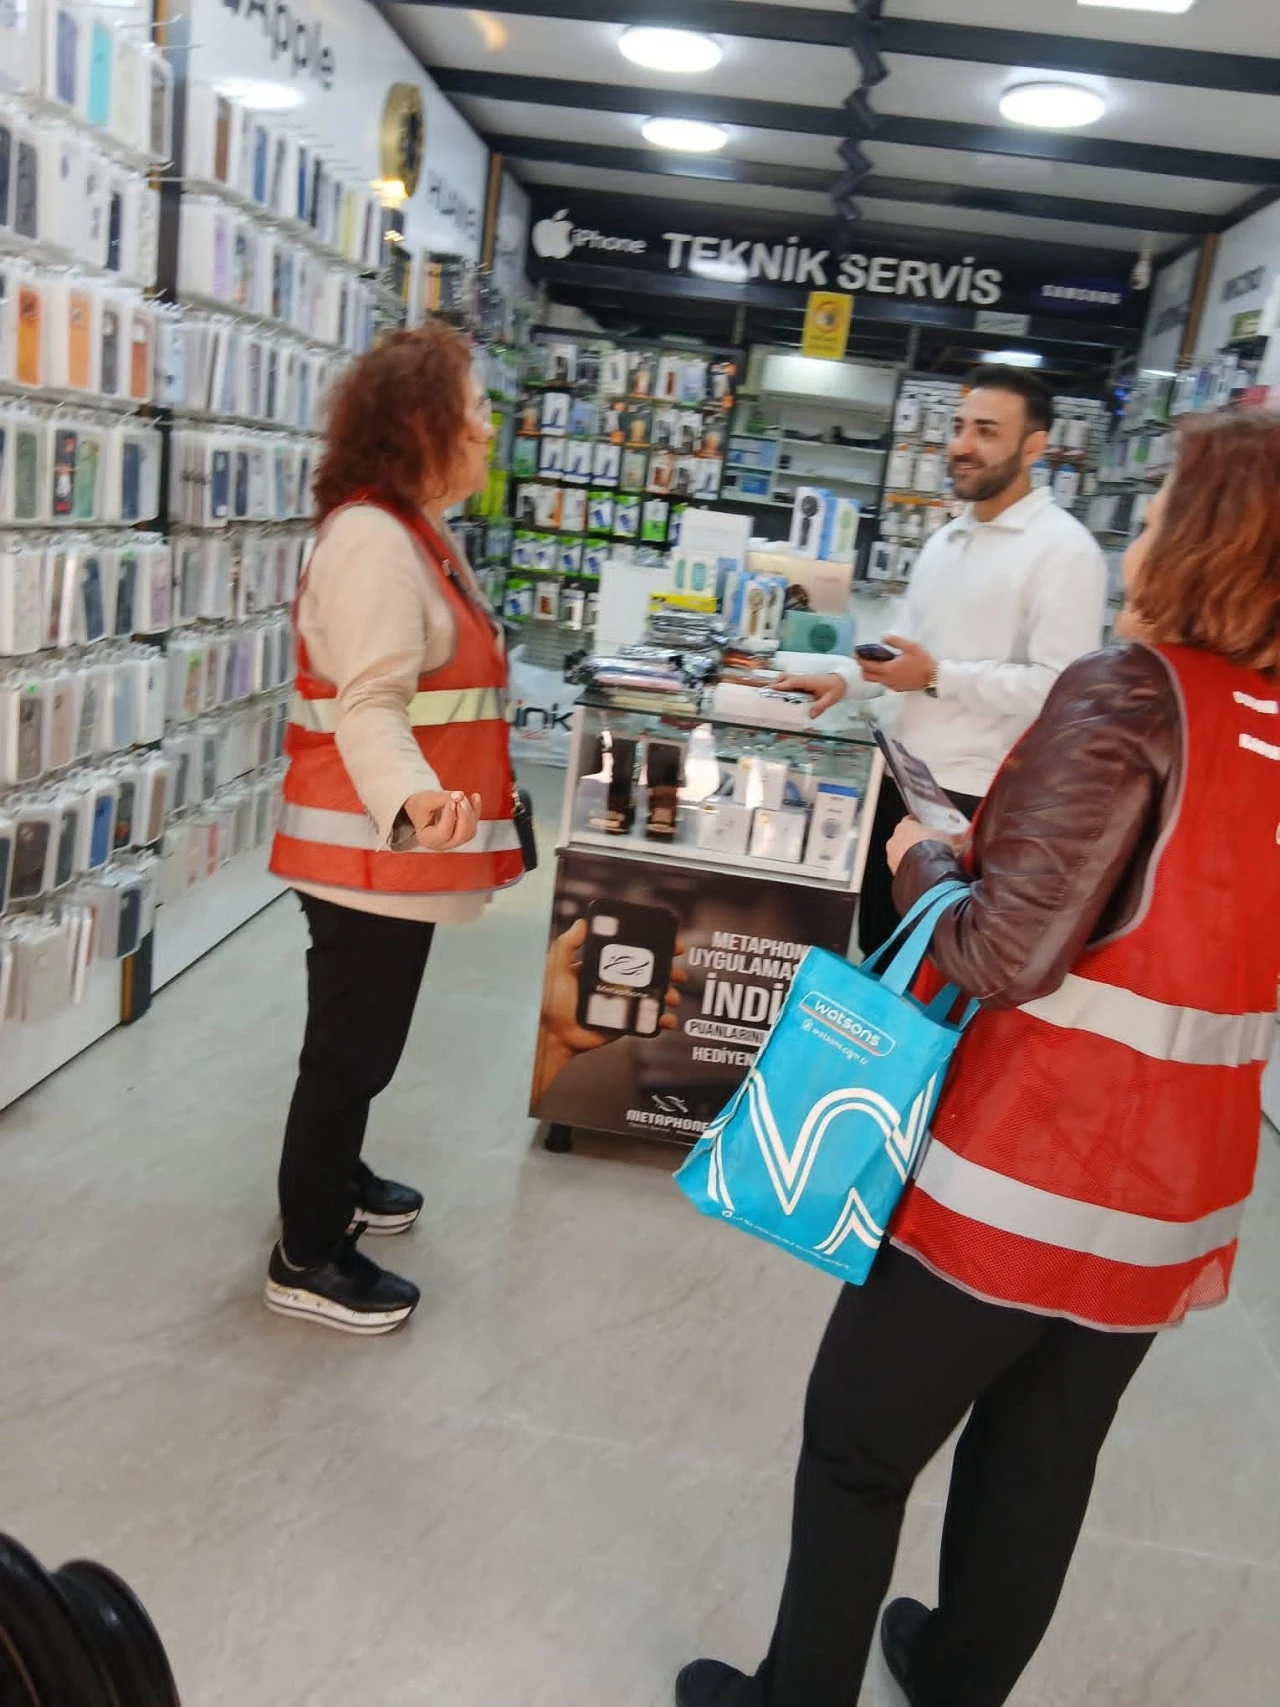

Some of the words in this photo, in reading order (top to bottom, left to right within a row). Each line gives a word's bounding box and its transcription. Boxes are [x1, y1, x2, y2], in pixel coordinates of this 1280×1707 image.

[572, 228, 648, 254] iPhone
[662, 231, 830, 286] TEKNİK
[836, 255, 1003, 305] SERVİS
[702, 972, 788, 1025] İNDİ
[814, 999, 880, 1047] watsons
